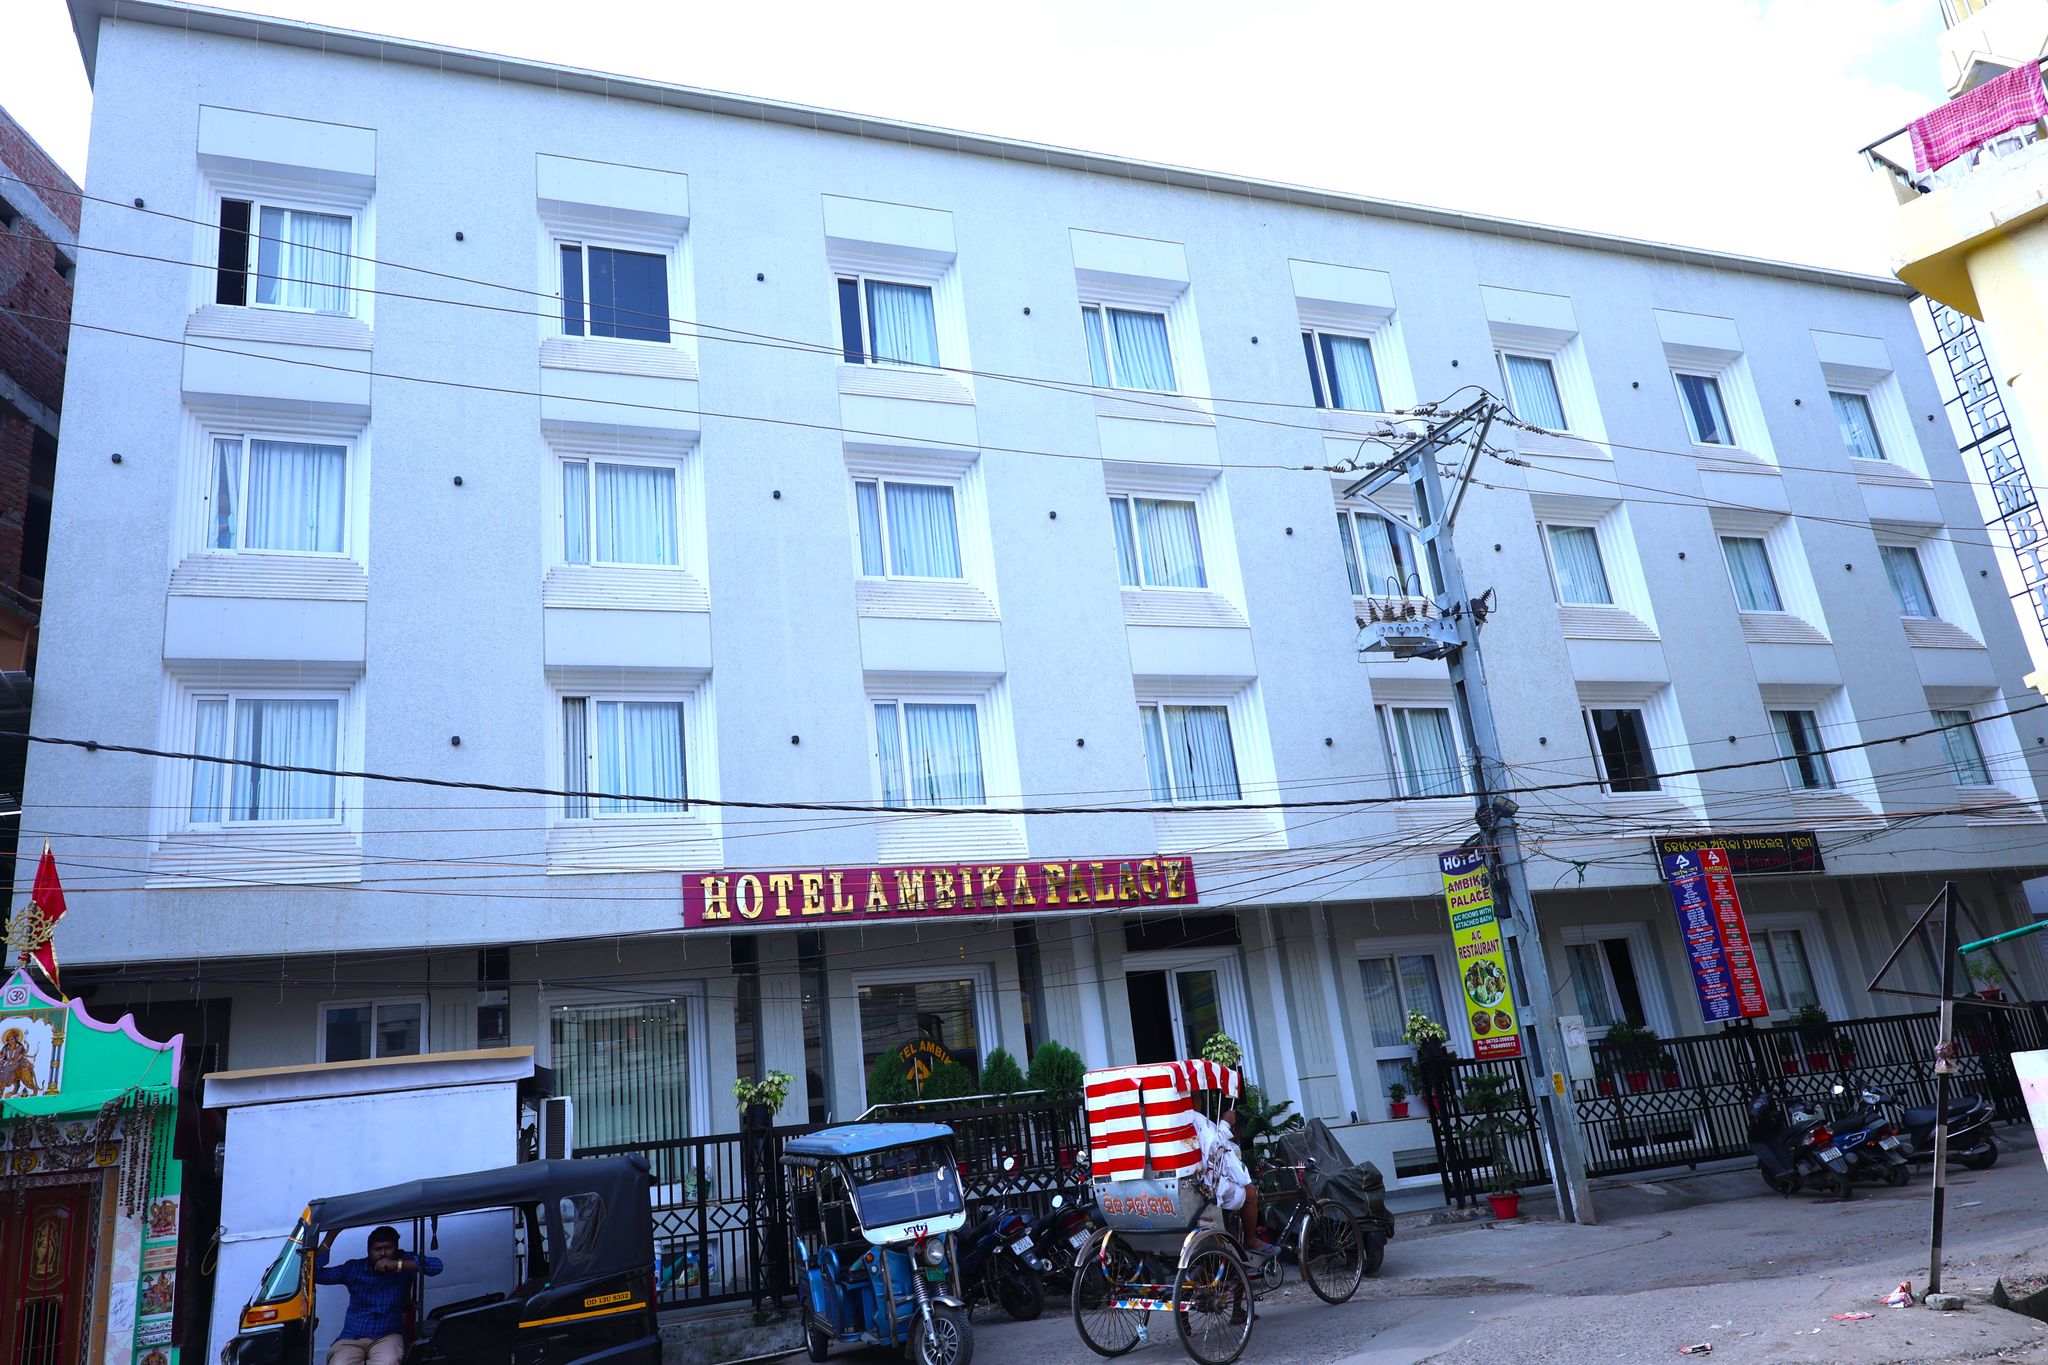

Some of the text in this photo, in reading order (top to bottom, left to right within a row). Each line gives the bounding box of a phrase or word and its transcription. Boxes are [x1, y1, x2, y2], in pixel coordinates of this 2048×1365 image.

[1935, 303, 2001, 438] OTEL
[700, 859, 1187, 920] HOTEL AMBIKA PALACE
[1450, 888, 1490, 908] PALACE
[1455, 915, 1493, 929] ATTACHED BATH
[1462, 909, 1479, 919] ROOMS
[1479, 907, 1492, 916] WITH
[1458, 939, 1500, 960] RESTAURANT
[903, 1222, 928, 1237] yatri
